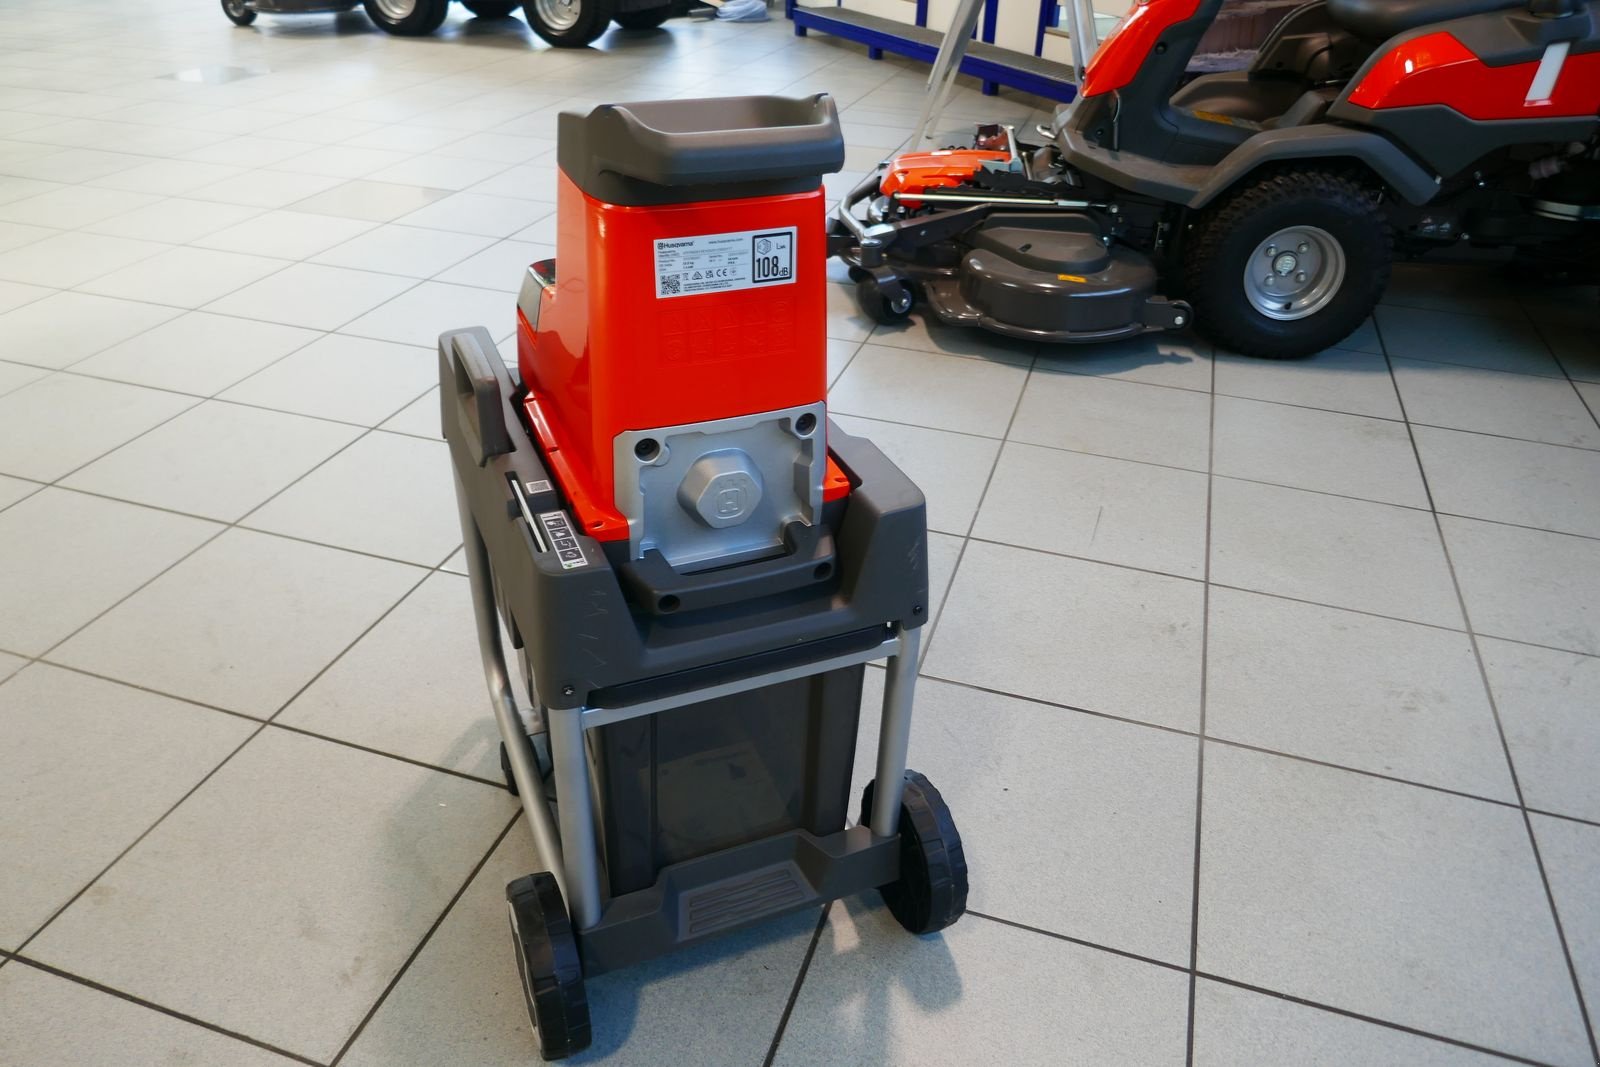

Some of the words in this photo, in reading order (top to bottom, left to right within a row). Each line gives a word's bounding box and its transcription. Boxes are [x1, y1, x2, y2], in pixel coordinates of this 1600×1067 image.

[663, 241, 694, 249] Husqvarna
[756, 256, 779, 278] 108
[779, 267, 789, 276] dB
